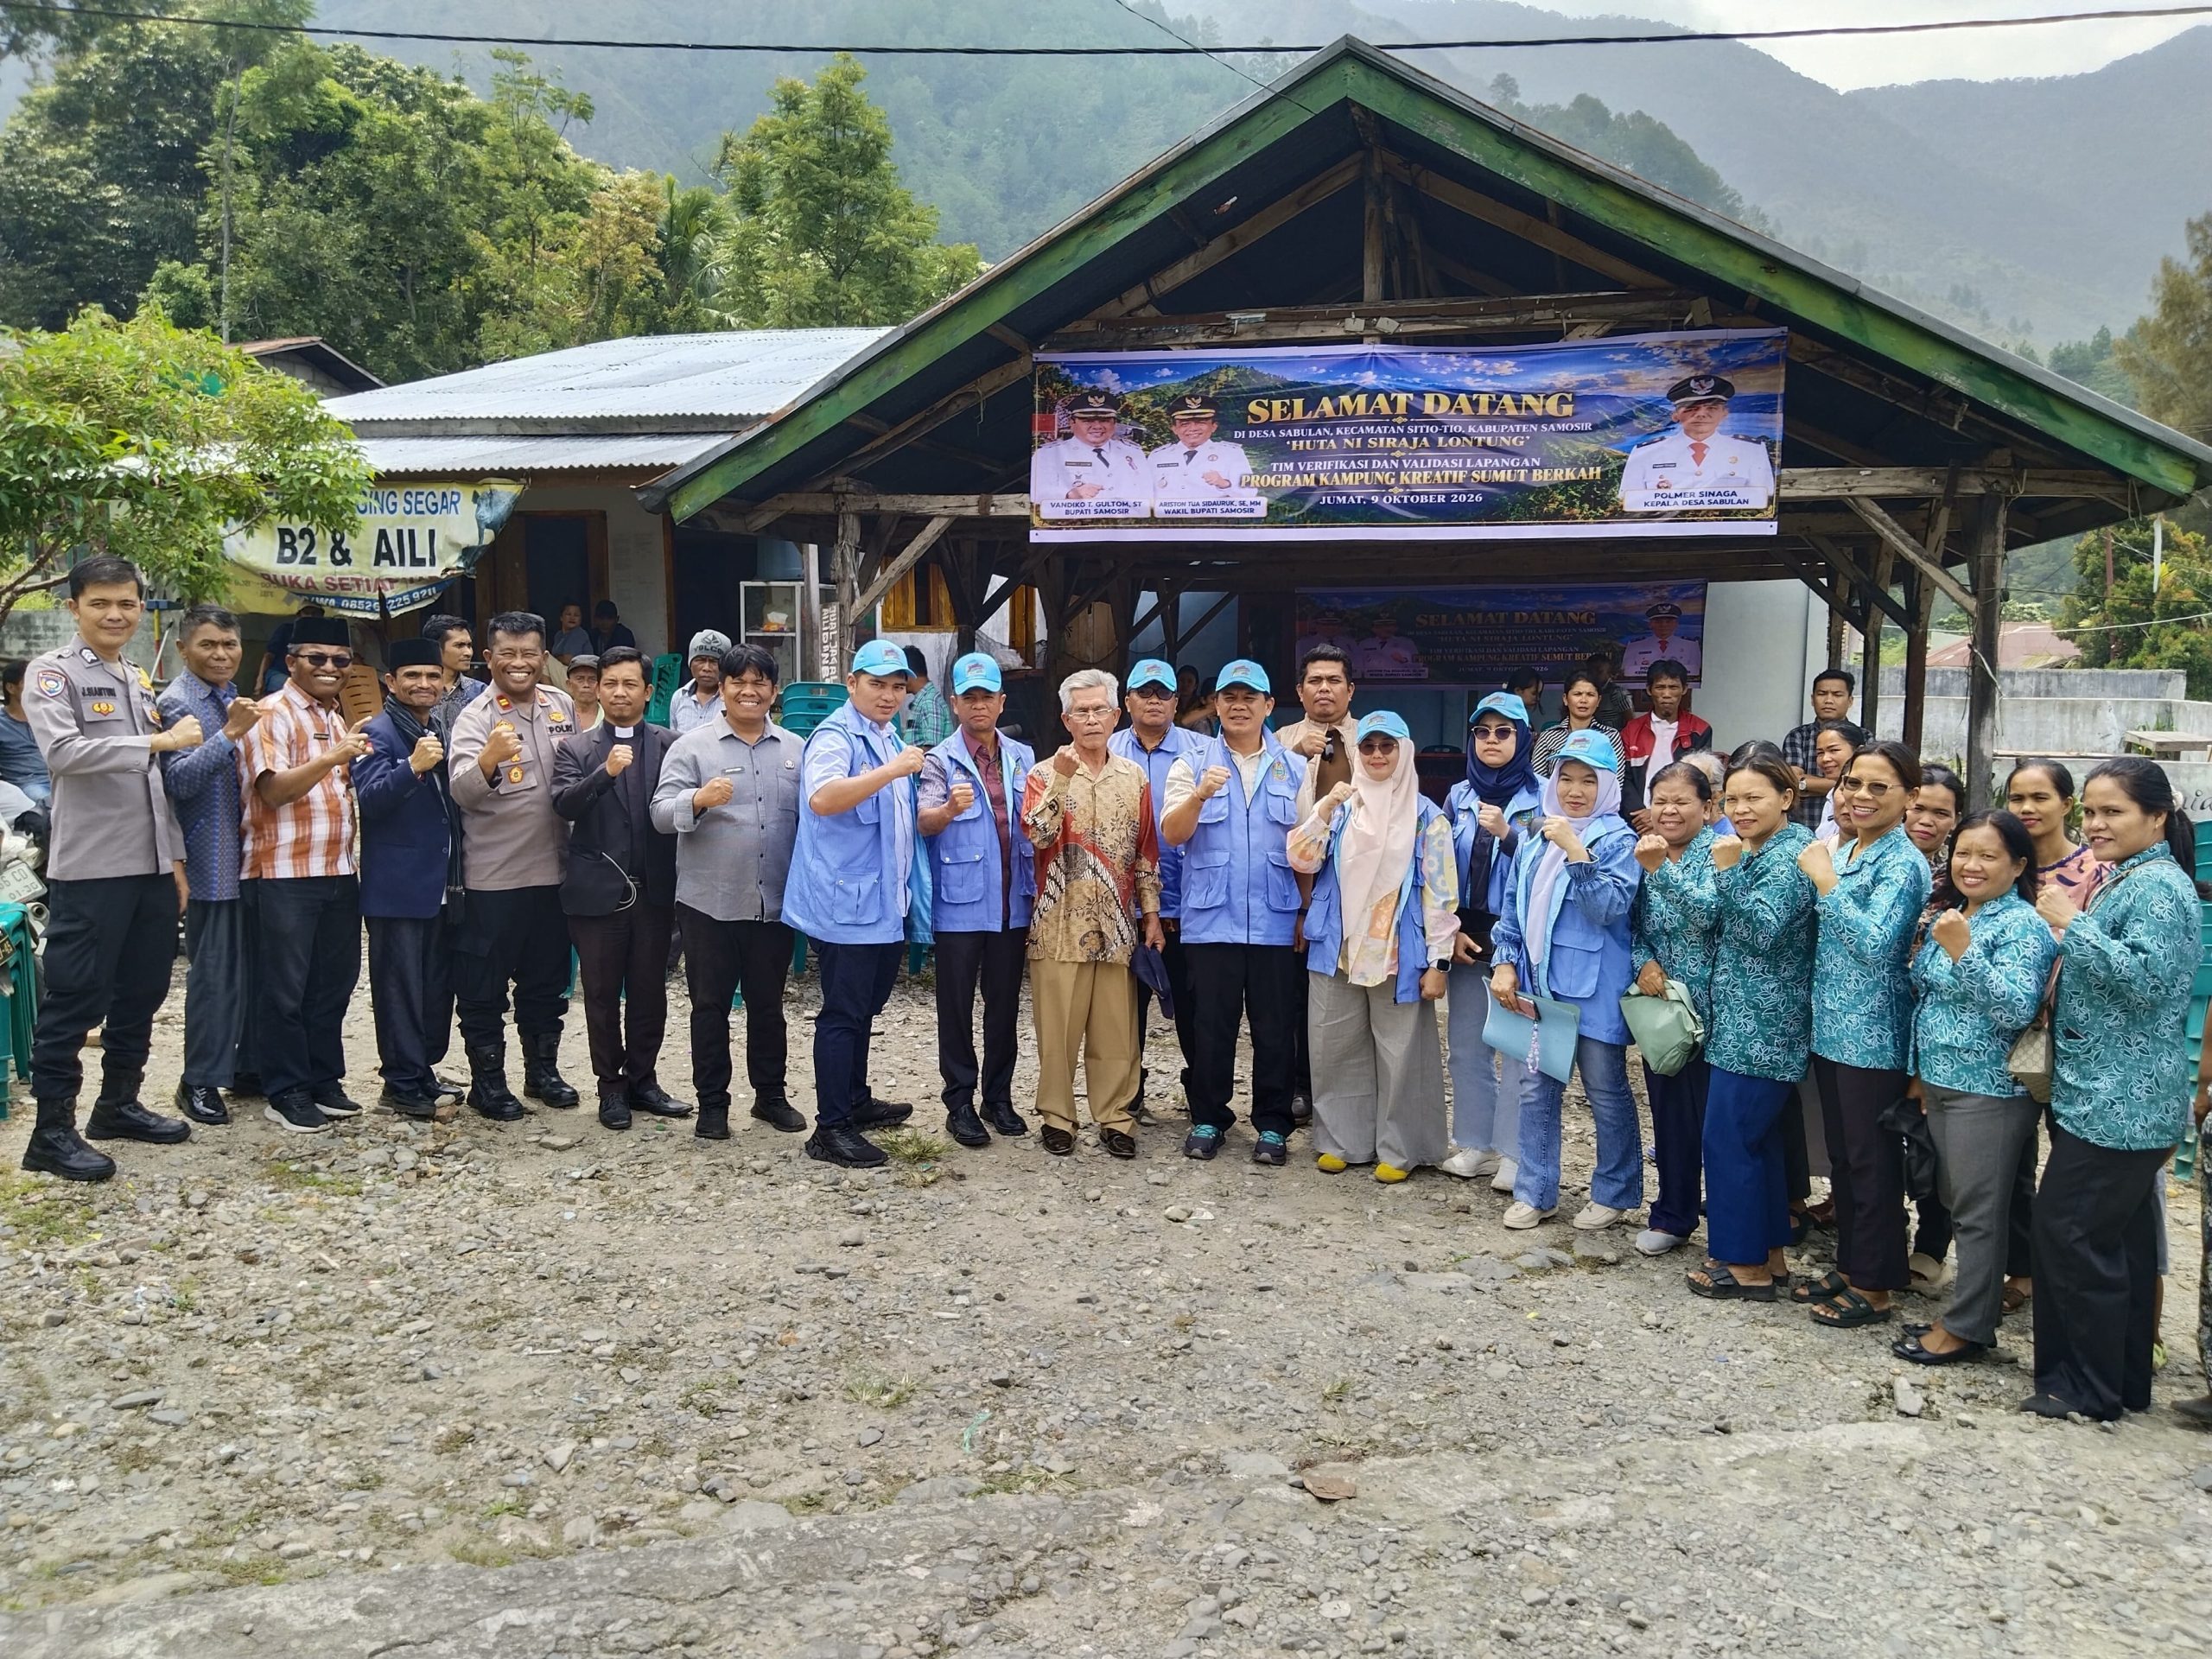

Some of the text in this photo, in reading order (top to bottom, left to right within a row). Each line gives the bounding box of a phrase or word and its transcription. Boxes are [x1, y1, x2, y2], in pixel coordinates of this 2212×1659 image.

[1248, 392, 1574, 424] SELAMAT DATANG
[1234, 430, 1245, 439] DI
[1249, 429, 1276, 438] DESA
[1336, 425, 1404, 435] KECAMATAN
[1468, 423, 1537, 433] KABUPATEN
[1541, 422, 1592, 432] SAMOSIR
[1344, 438, 1362, 448] NI
[1368, 436, 1430, 450] SIRAJA
[1271, 457, 1541, 472] TIM VERIFIKASI DAN VALIDASI LAPANGAN
[1240, 467, 1602, 488] PROGRAM KAMPUNG KREATIF SUMUT BERKAH
[403, 490, 461, 515] SEGAR
[1319, 493, 1483, 505] JUMAT, 9 OKTOBER 2026
[276, 527, 436, 567] B2 & AILI
[1415, 611, 1596, 627] SELAMAT DATANG
[1541, 652, 1572, 661] SUMUT
[549, 724, 572, 734] POLRI
